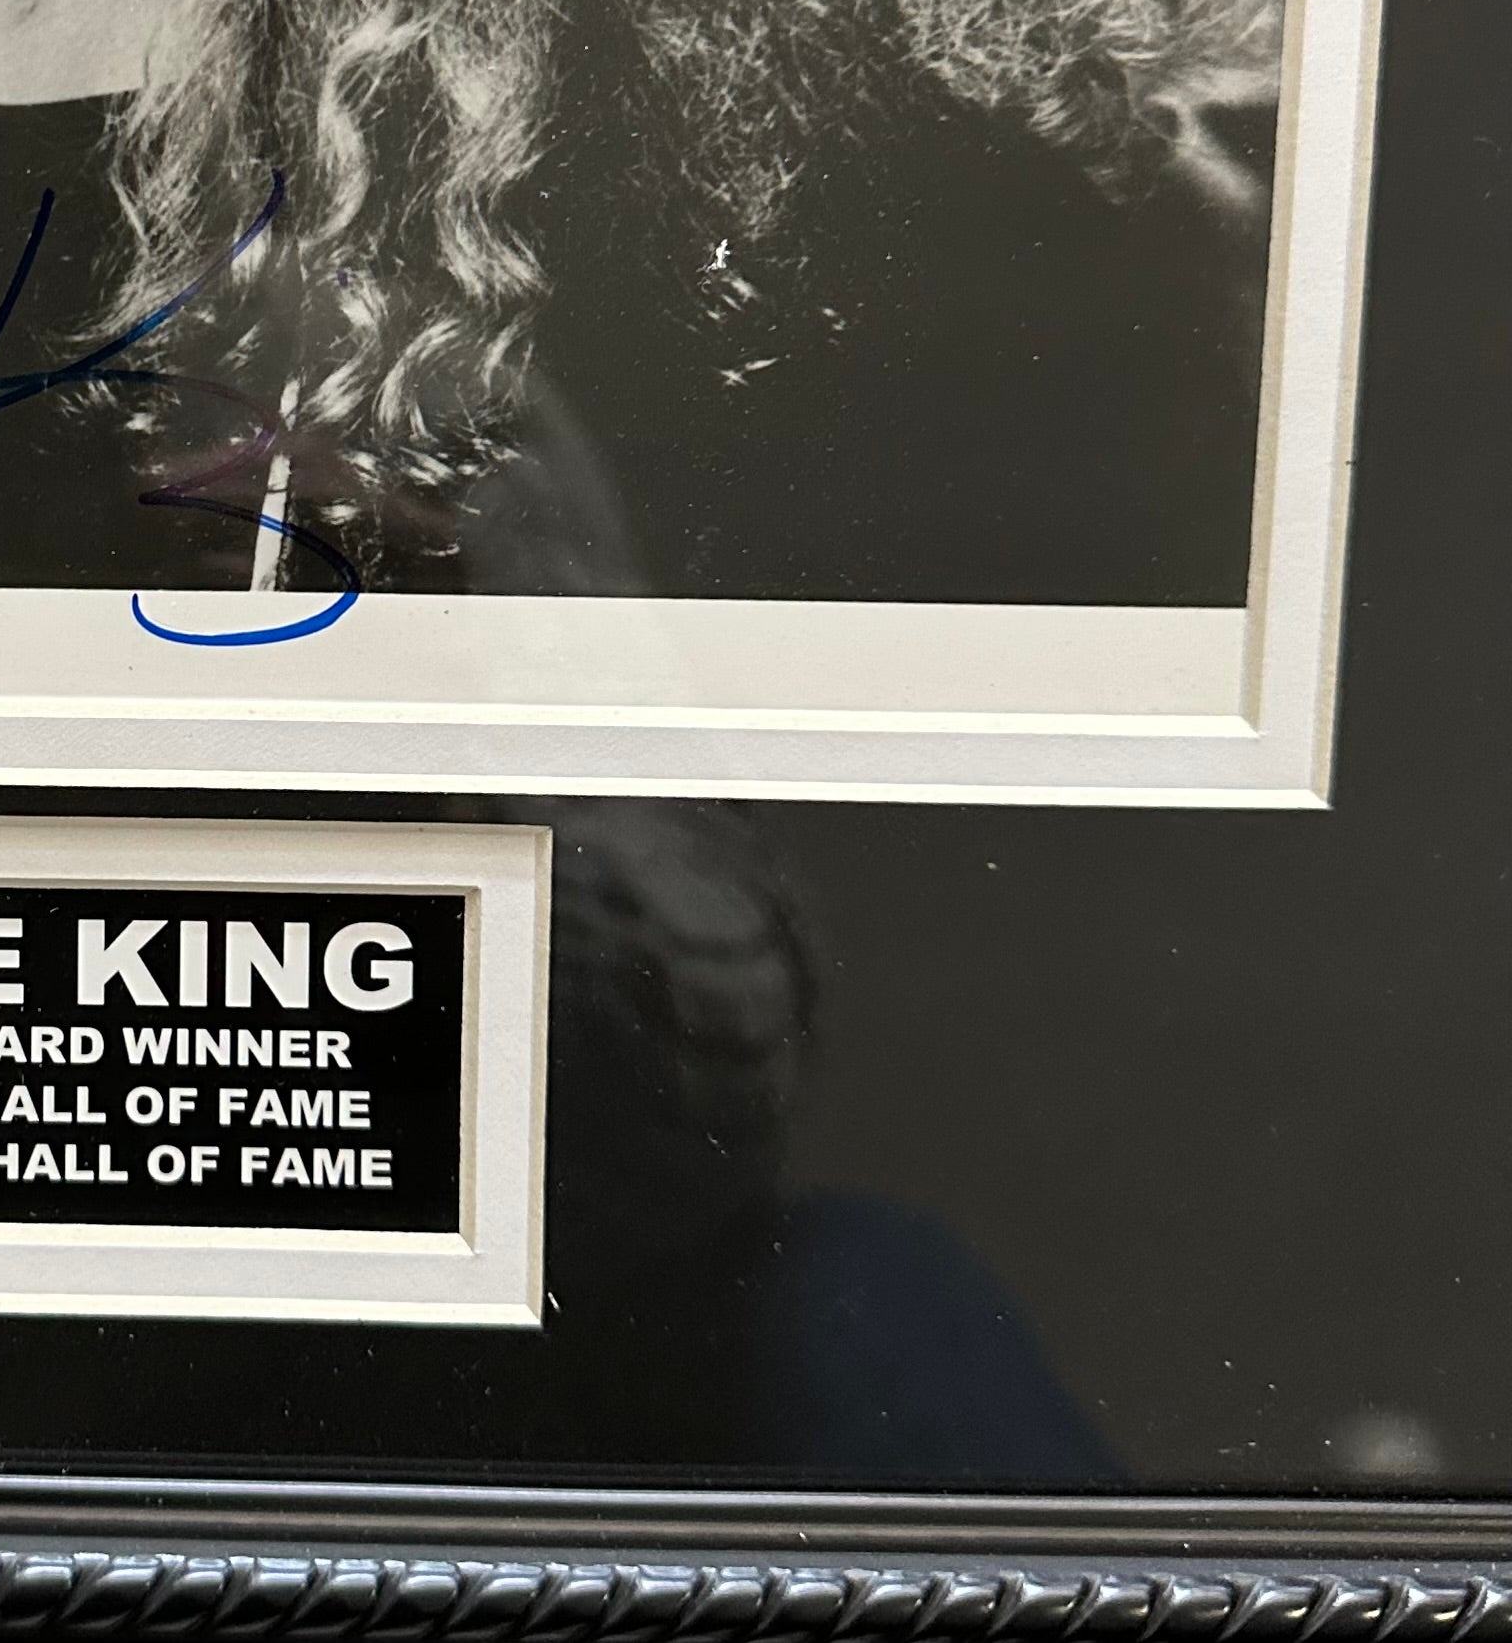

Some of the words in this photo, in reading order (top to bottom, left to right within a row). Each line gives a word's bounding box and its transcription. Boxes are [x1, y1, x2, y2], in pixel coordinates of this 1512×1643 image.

[76, 917, 415, 1013] KING
[121, 1026, 353, 1070] WINNER
[124, 1084, 199, 1126] OF
[217, 1086, 372, 1130] FAME
[146, 1143, 221, 1185] OF
[239, 1145, 394, 1189] FAME
